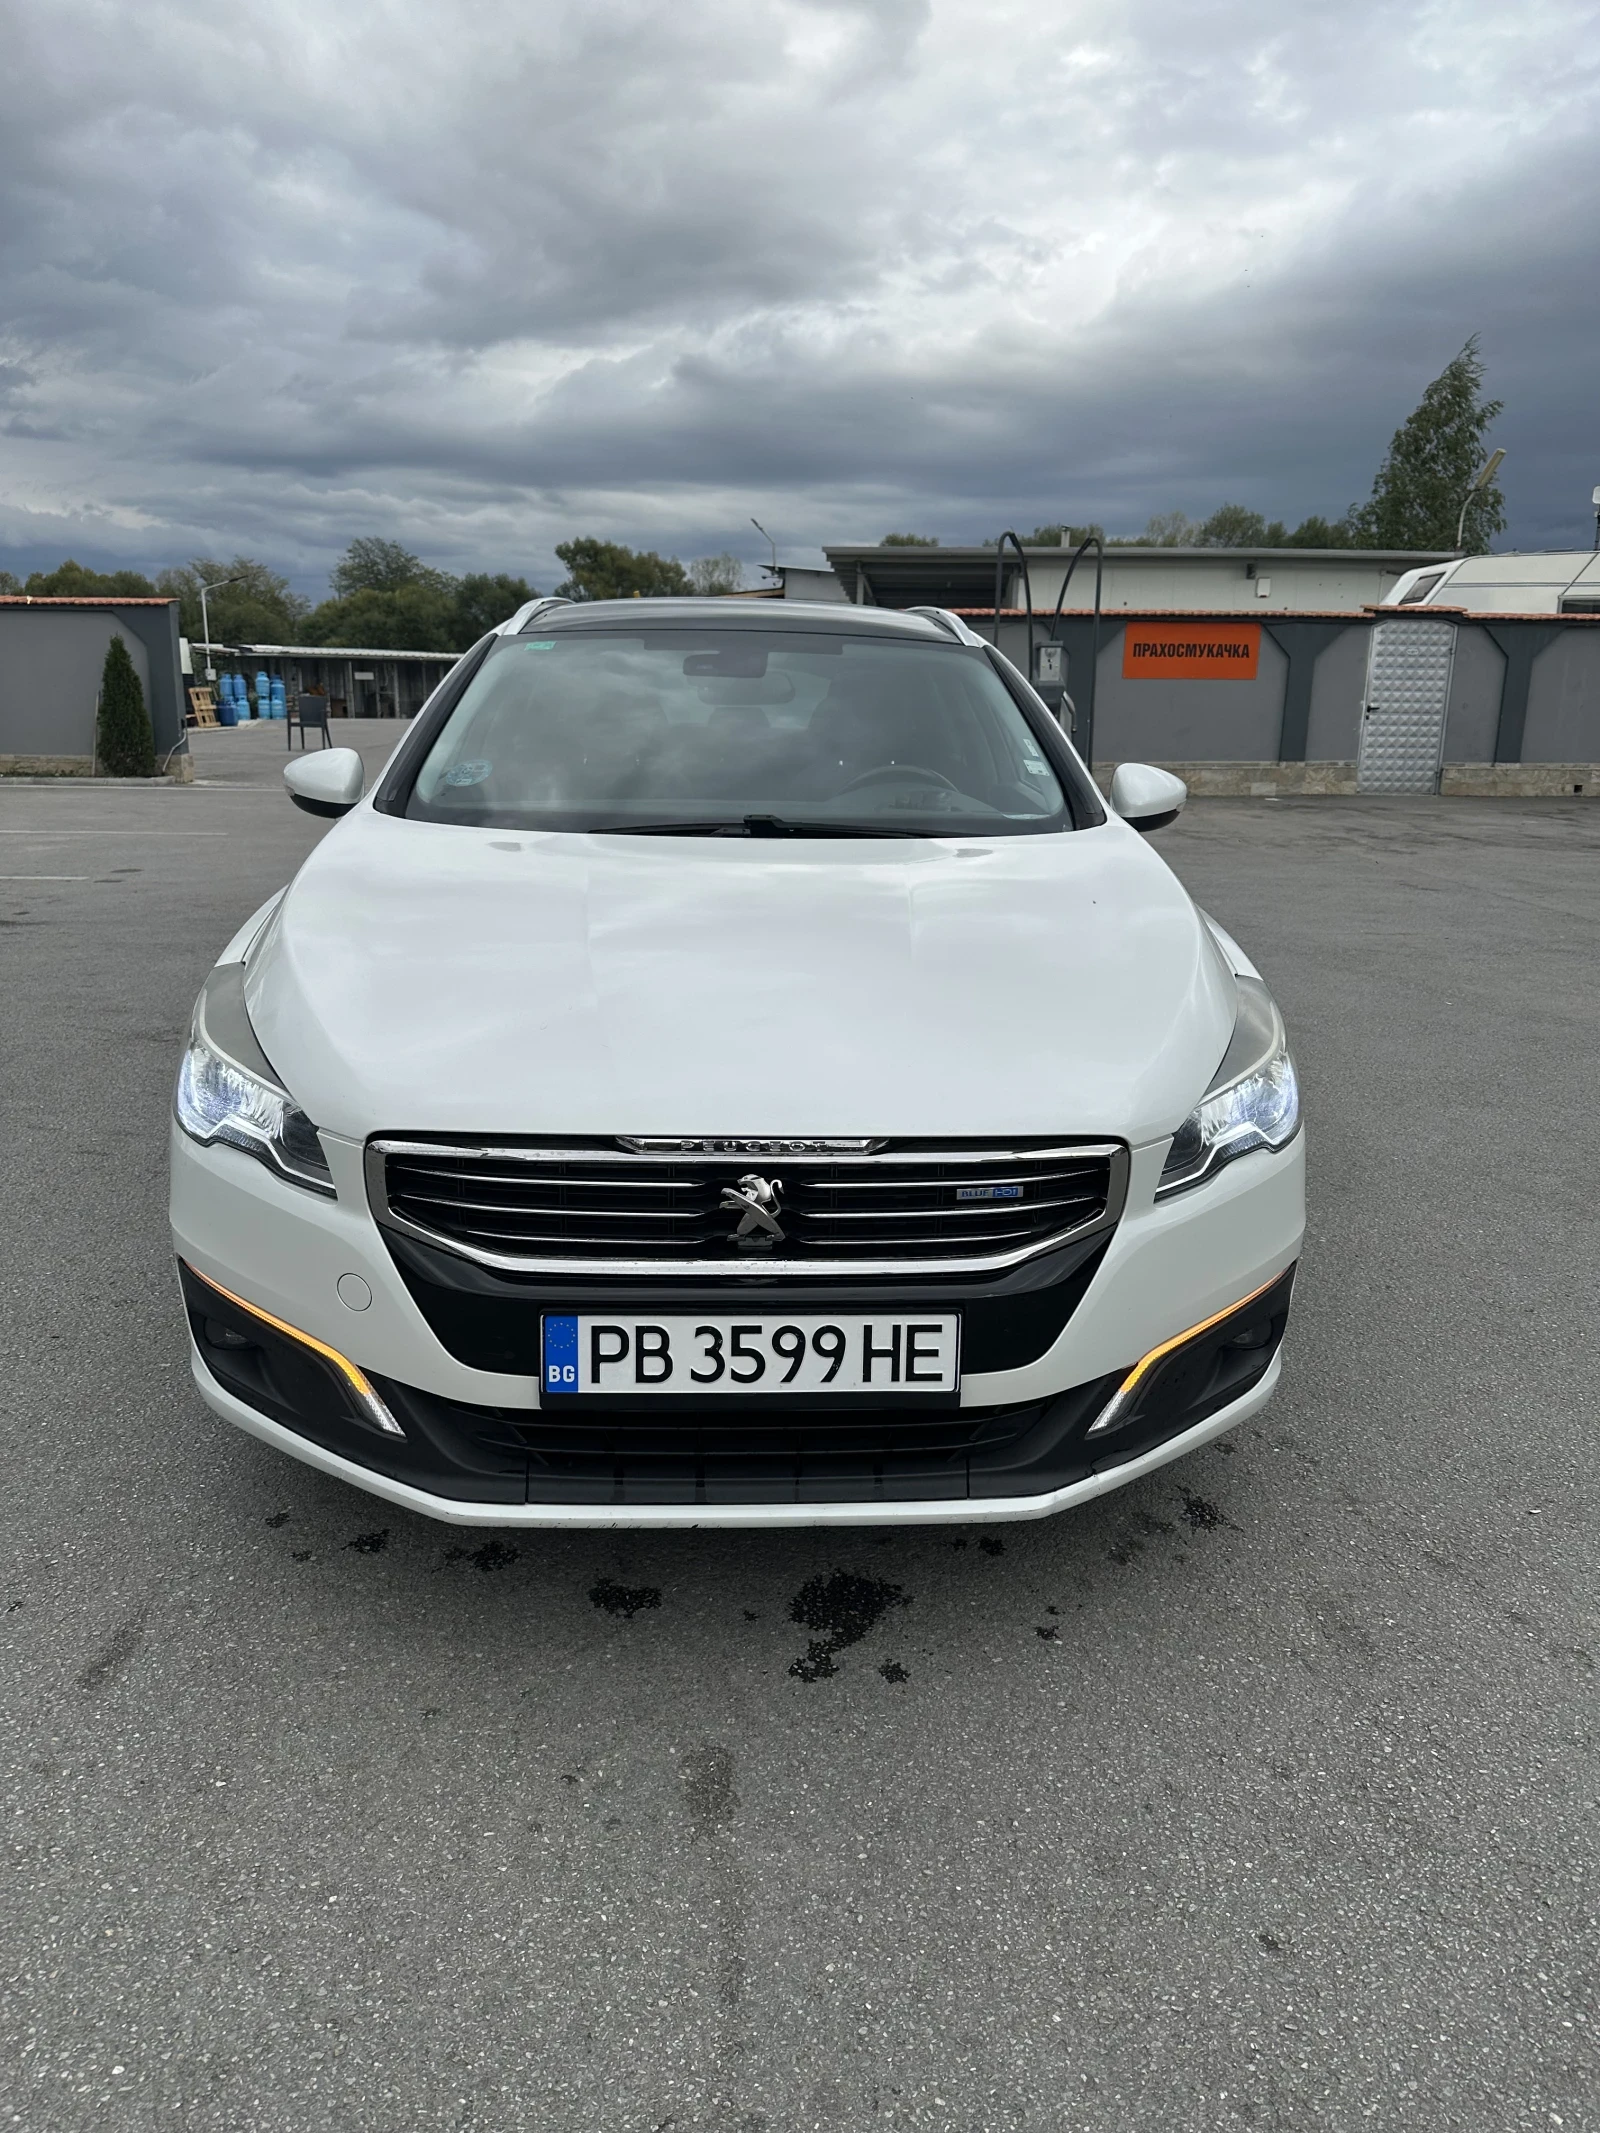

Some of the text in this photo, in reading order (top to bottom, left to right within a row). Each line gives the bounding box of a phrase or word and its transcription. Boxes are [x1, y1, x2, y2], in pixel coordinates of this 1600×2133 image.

[1132, 643, 1250, 658] ПРАХОСМУКАЧКА
[680, 1140, 826, 1151] PEUGEOT
[590, 1323, 943, 1384] PB 3599 HE
[548, 1365, 576, 1383] BG
